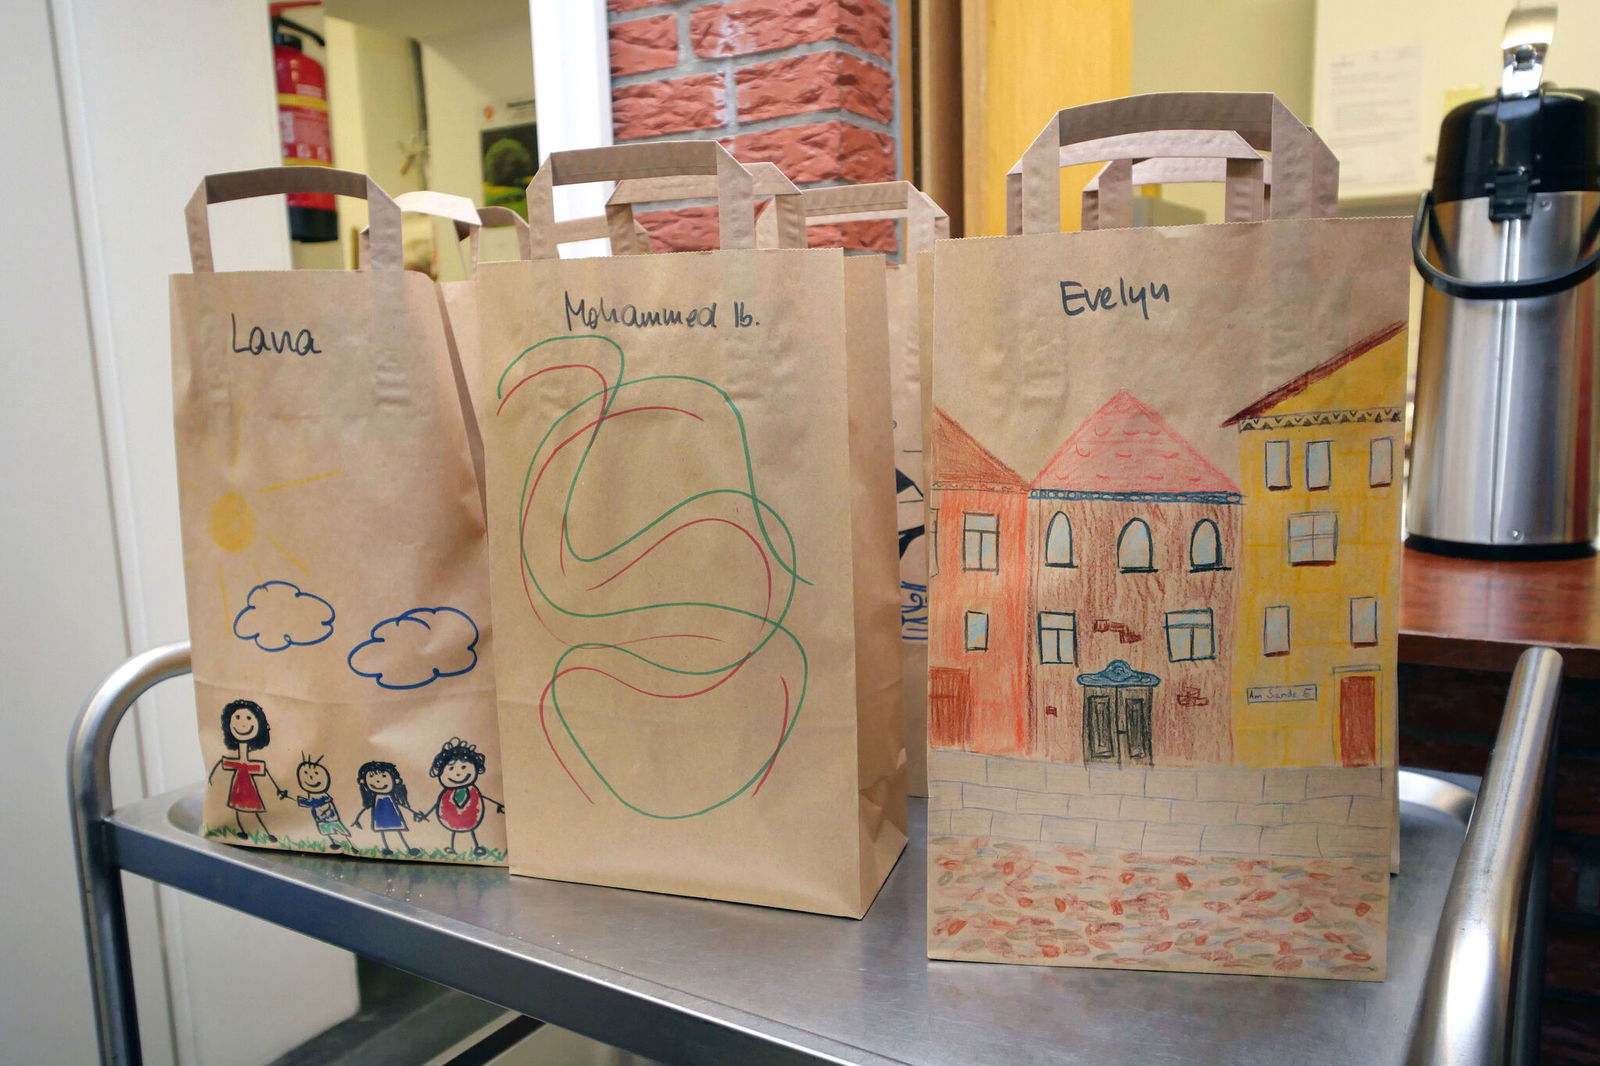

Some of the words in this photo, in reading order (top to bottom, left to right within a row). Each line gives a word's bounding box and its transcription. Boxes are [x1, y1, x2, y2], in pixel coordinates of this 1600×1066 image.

[564, 290, 718, 332] Mohammed
[1060, 276, 1170, 320] Evelyn
[231, 312, 323, 356] Lana
